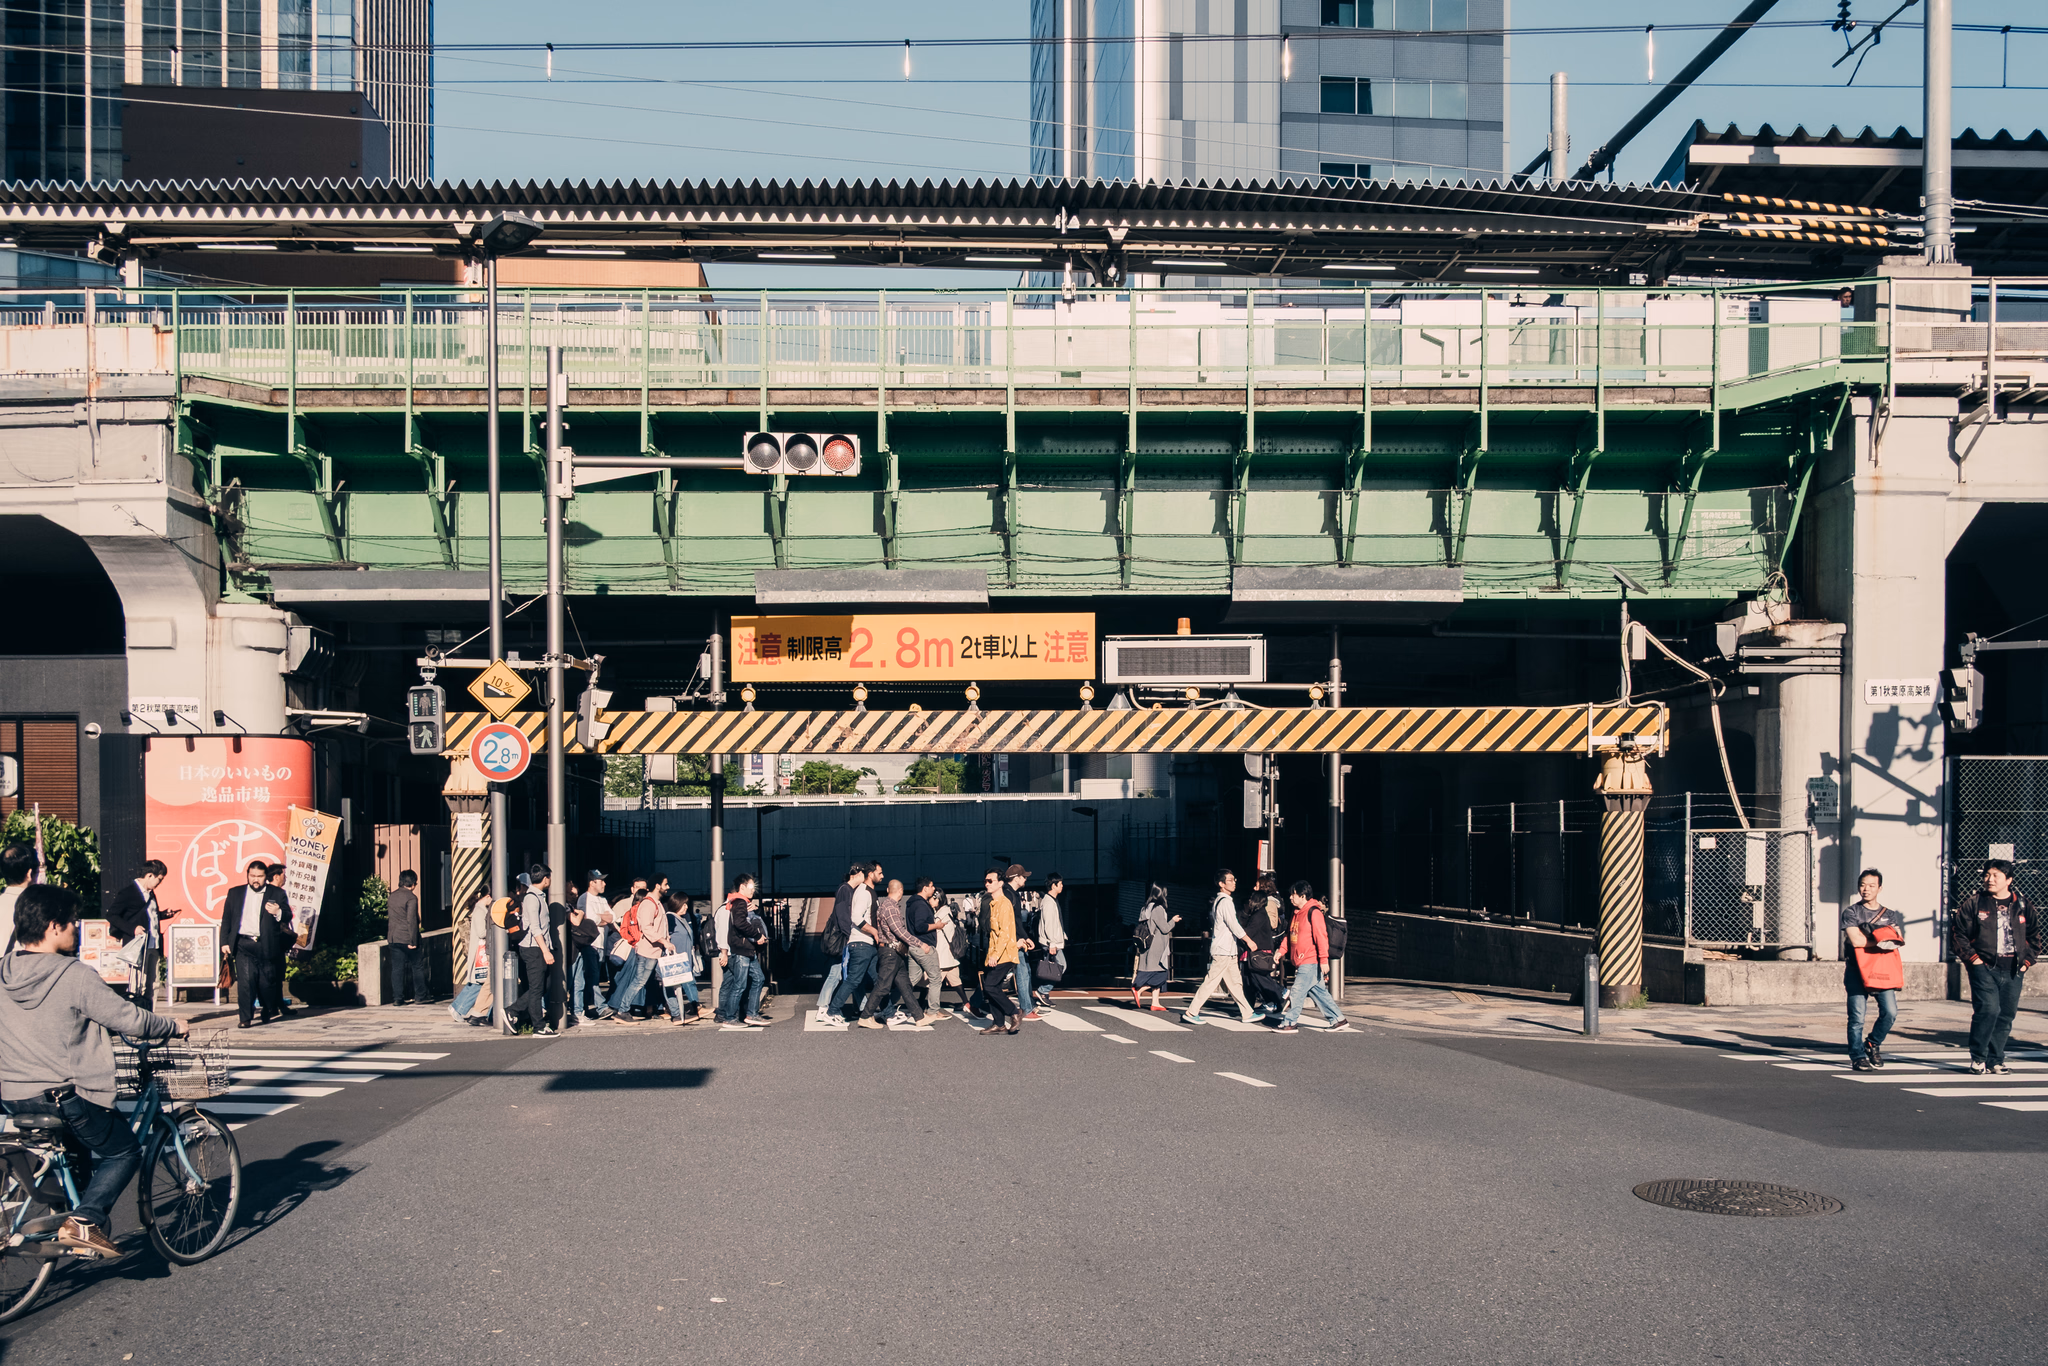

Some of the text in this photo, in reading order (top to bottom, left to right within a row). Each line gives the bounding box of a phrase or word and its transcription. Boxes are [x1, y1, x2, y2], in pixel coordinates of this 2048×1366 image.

[737, 627, 1089, 668] 注意 制限高 2.8m 2t車以上 注意
[490, 675, 515, 694] 10%
[1870, 685, 1931, 697] 第1秋葉原高架橋
[483, 739, 519, 765] 2.8m
[179, 764, 292, 782] 日本のいいもの
[201, 786, 271, 803] 逸品市場
[290, 836, 329, 853] MONEY
[288, 891, 314, 904] 화환전
